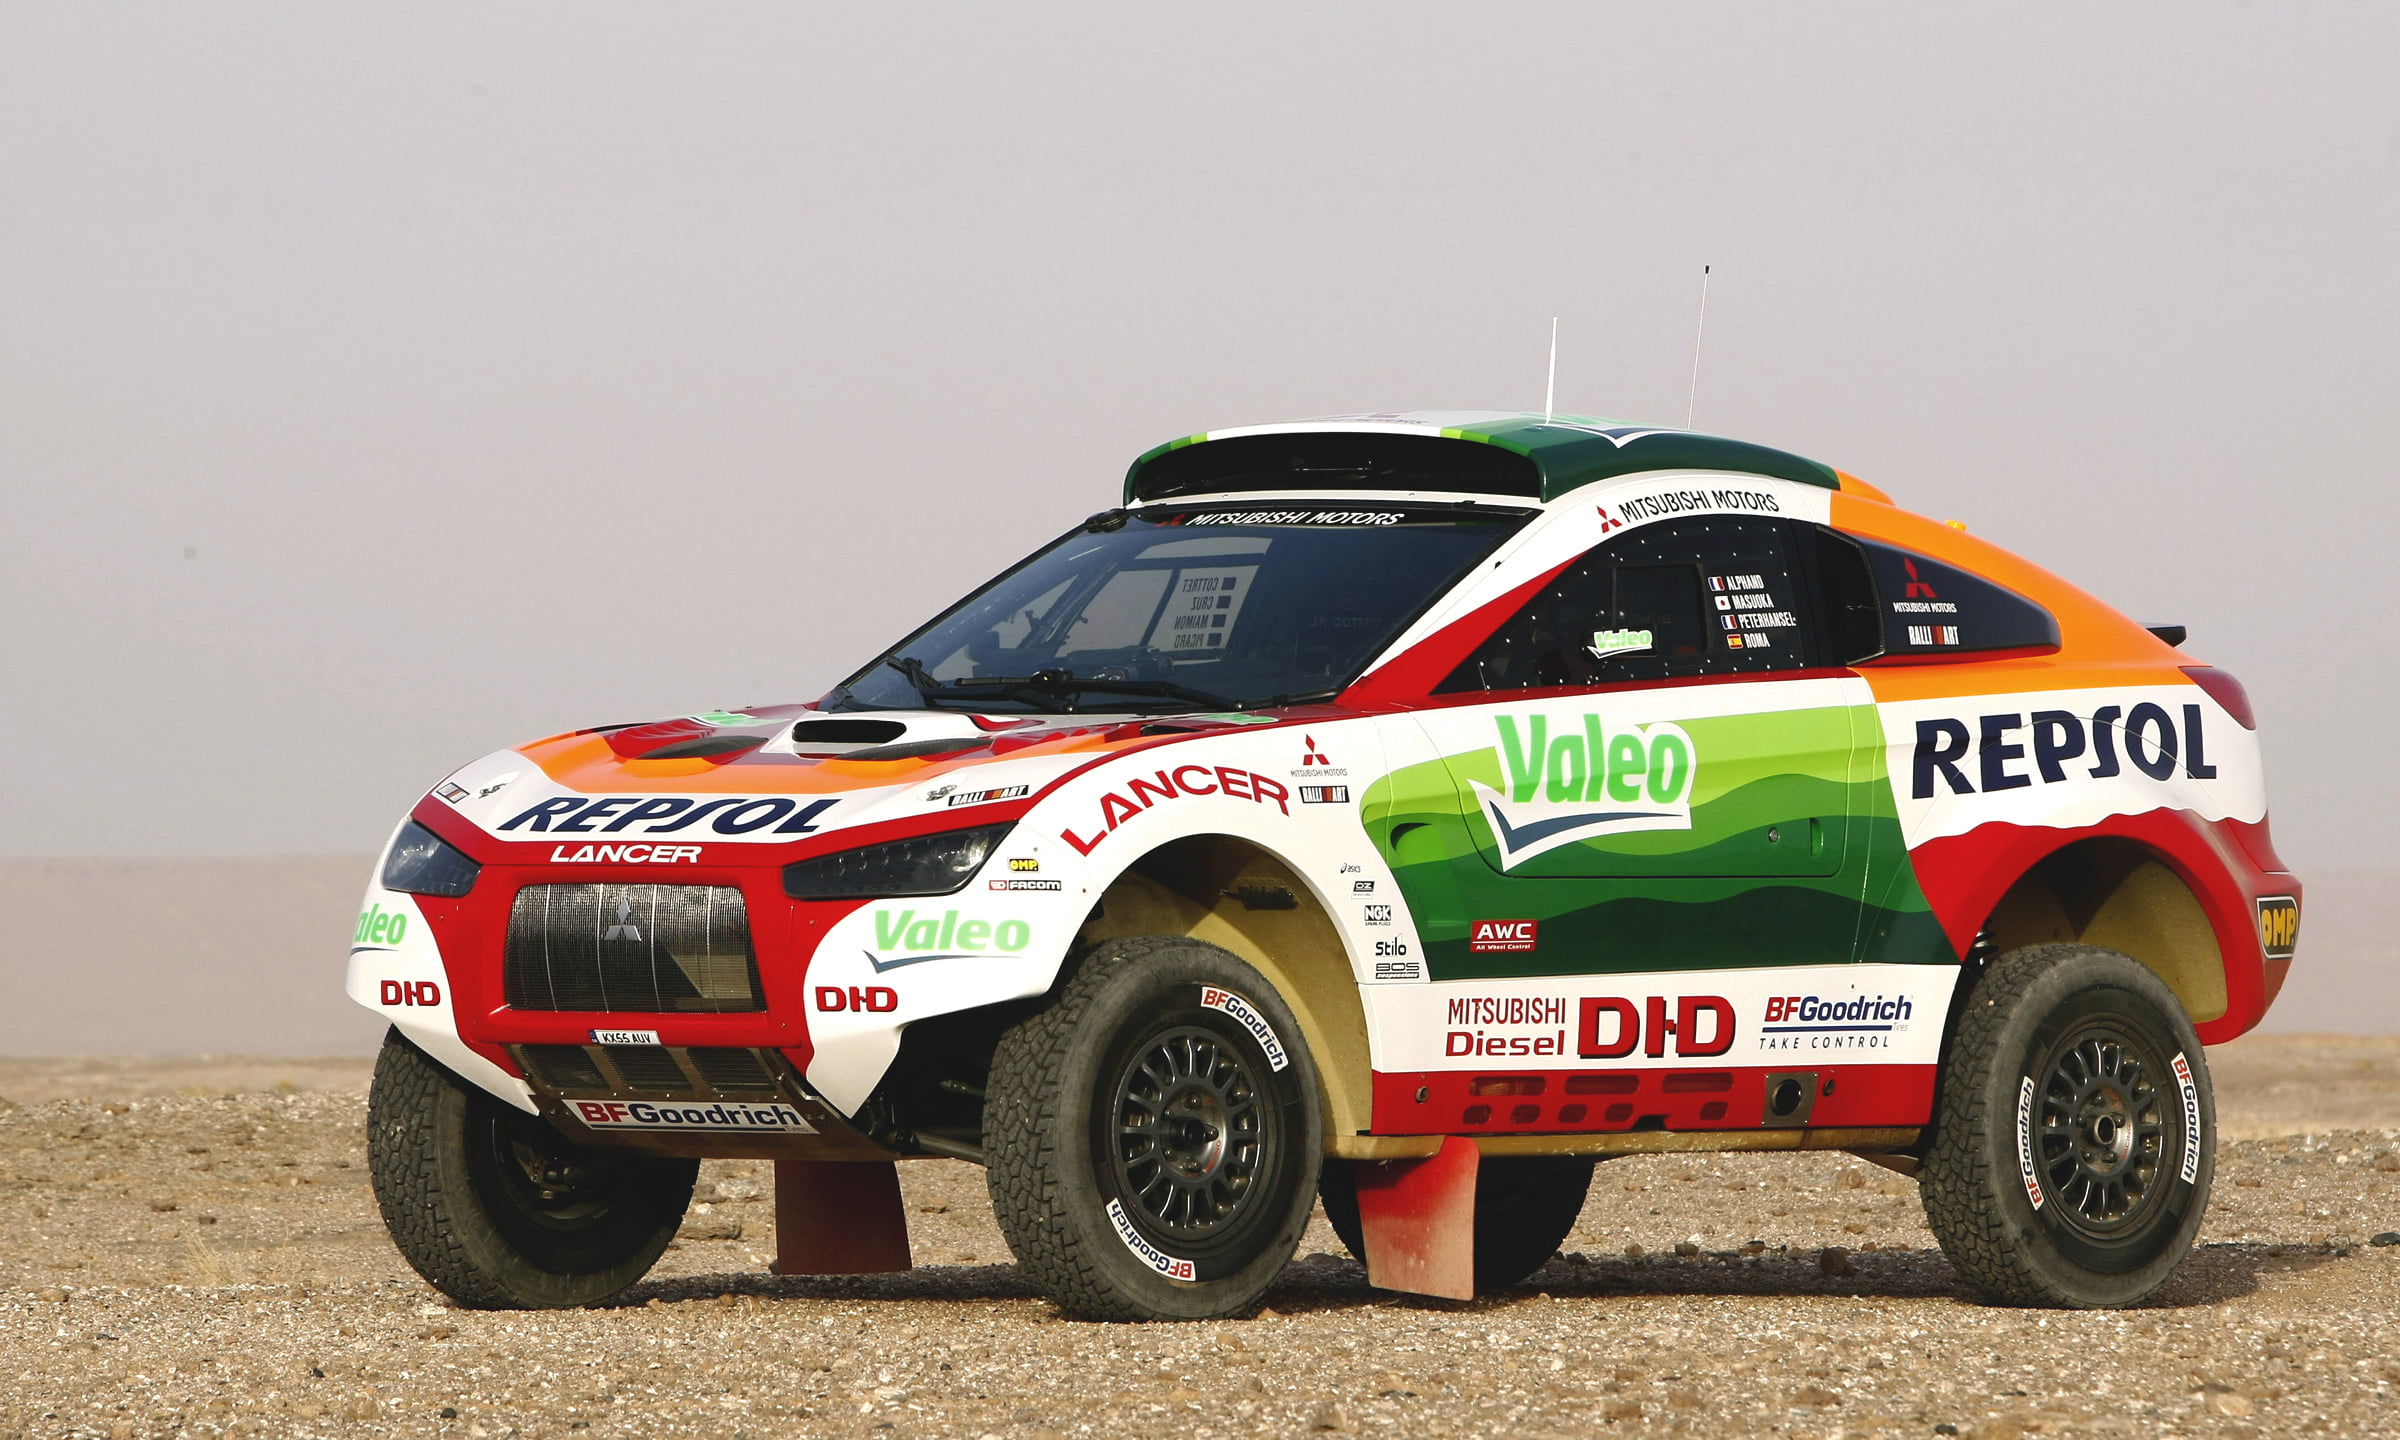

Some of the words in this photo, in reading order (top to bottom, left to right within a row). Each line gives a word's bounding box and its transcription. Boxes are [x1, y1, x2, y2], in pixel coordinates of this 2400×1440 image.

[1618, 490, 1712, 523] MITSUBISHI
[1711, 490, 1780, 512] MOTORS
[1185, 511, 1307, 526] MITSUBISHI
[1305, 512, 1405, 526] MOTORS
[1725, 574, 1765, 591] ALPHAND
[1731, 593, 1774, 610] MASUOKA
[1892, 602, 1931, 613] MITSUBISHI
[1930, 602, 1958, 613] MOTORS
[1738, 612, 1795, 629] PETERHANSEL
[1595, 629, 1652, 648] Valeo
[1744, 633, 1771, 648] ROMA
[1494, 713, 1690, 804] Valeo
[1912, 702, 2217, 800] REPSOL
[1290, 769, 1323, 778] MITSUBISHI
[1323, 768, 1348, 777] MOTORS
[495, 797, 843, 835] REPSOL
[1060, 765, 1290, 857] LANCER
[549, 845, 703, 864] LANCER
[1009, 880, 1061, 890] FACOM
[1355, 882, 1373, 890] OZ
[1364, 905, 1391, 921] NGK
[354, 903, 407, 945] aleo
[874, 909, 1031, 952] Valeo
[1477, 923, 1532, 940] AWC
[2261, 907, 2297, 947] OMP
[1375, 936, 1407, 956] Stilo
[1375, 962, 1420, 972] BOS
[1448, 997, 1566, 1025] MITSUBISHI
[1764, 995, 1913, 1022] BFGoodrich
[1203, 989, 1284, 1067] BFGoodrich
[1892, 1022, 1909, 1032] Tires
[632, 1033, 652, 1043] AUV
[1445, 1030, 1565, 1057] Diesel
[1759, 1037, 1800, 1050] TAKE
[1811, 1036, 1889, 1049] CONTROL
[575, 1101, 801, 1126] BFGoodrich
[2174, 1059, 2200, 1181] BFGoodrich
[2019, 1081, 2043, 1206] BFGoodrich
[1111, 1203, 1193, 1279] BFGoodrich
